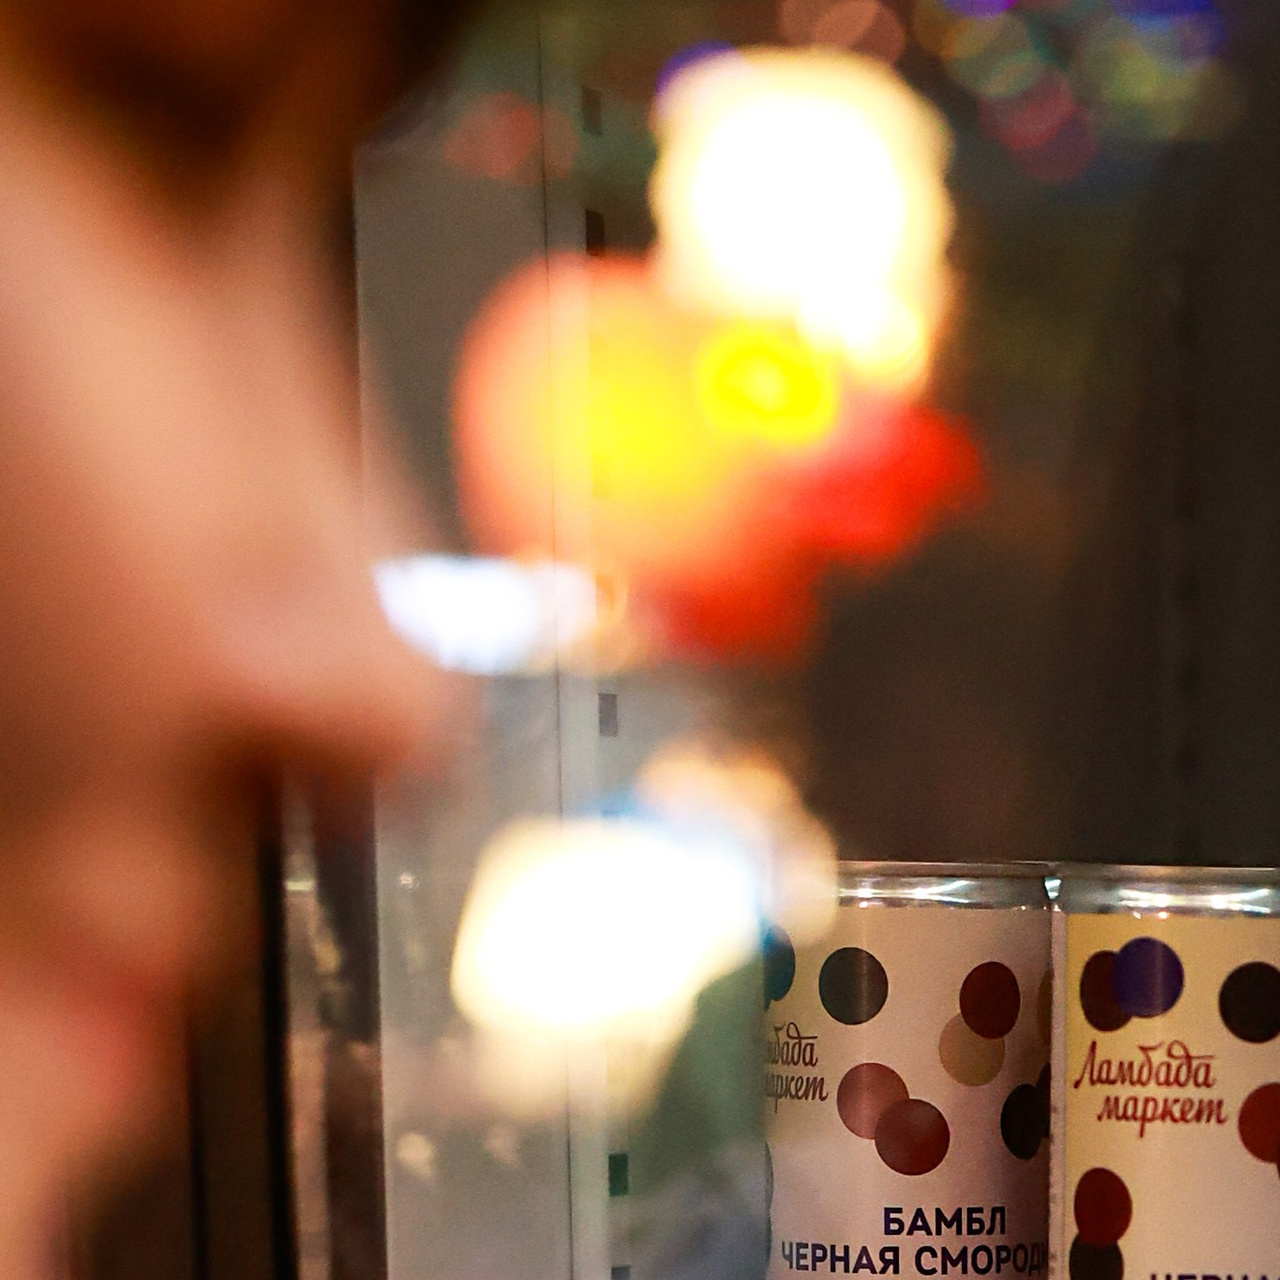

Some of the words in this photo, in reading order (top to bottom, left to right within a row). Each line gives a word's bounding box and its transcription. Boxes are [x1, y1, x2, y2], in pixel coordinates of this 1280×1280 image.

[1074, 1039, 1217, 1089] Ламбада
[1097, 1095, 1228, 1138] маркет
[884, 1206, 1006, 1236] БАМБЛ
[782, 1241, 900, 1275] ЧЕРНАЯ
